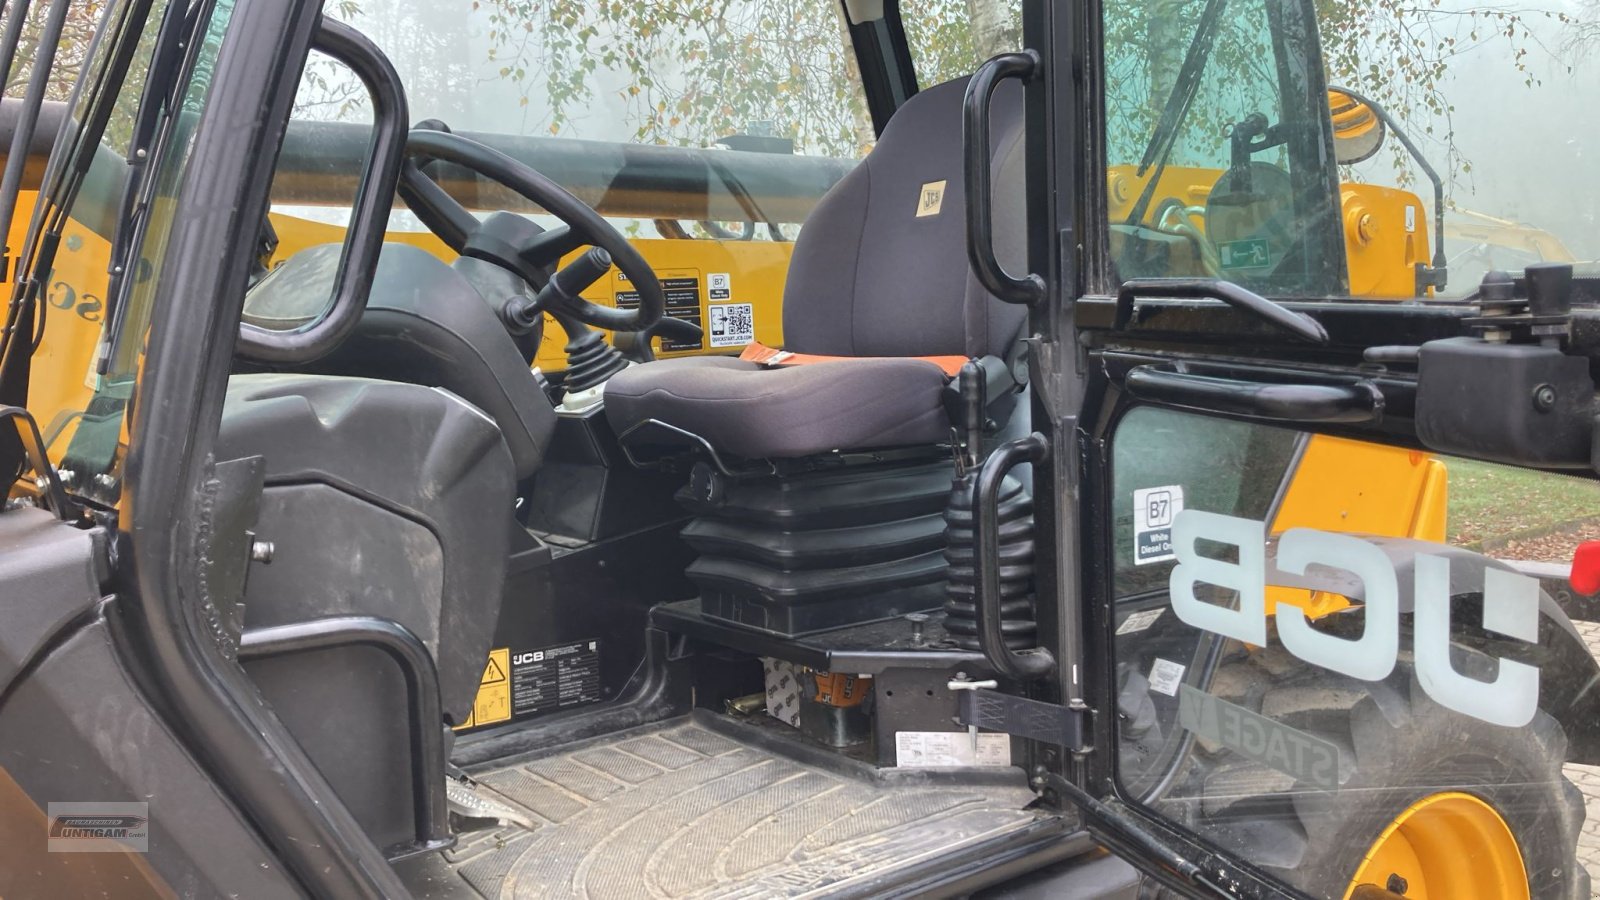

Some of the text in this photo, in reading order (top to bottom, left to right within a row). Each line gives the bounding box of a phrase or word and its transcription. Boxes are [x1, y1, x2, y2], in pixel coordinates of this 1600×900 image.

[1150, 500, 1168, 519] B7
[1150, 533, 1169, 543] White
[1141, 544, 1162, 554] Diesel
[513, 651, 544, 665] JCB
